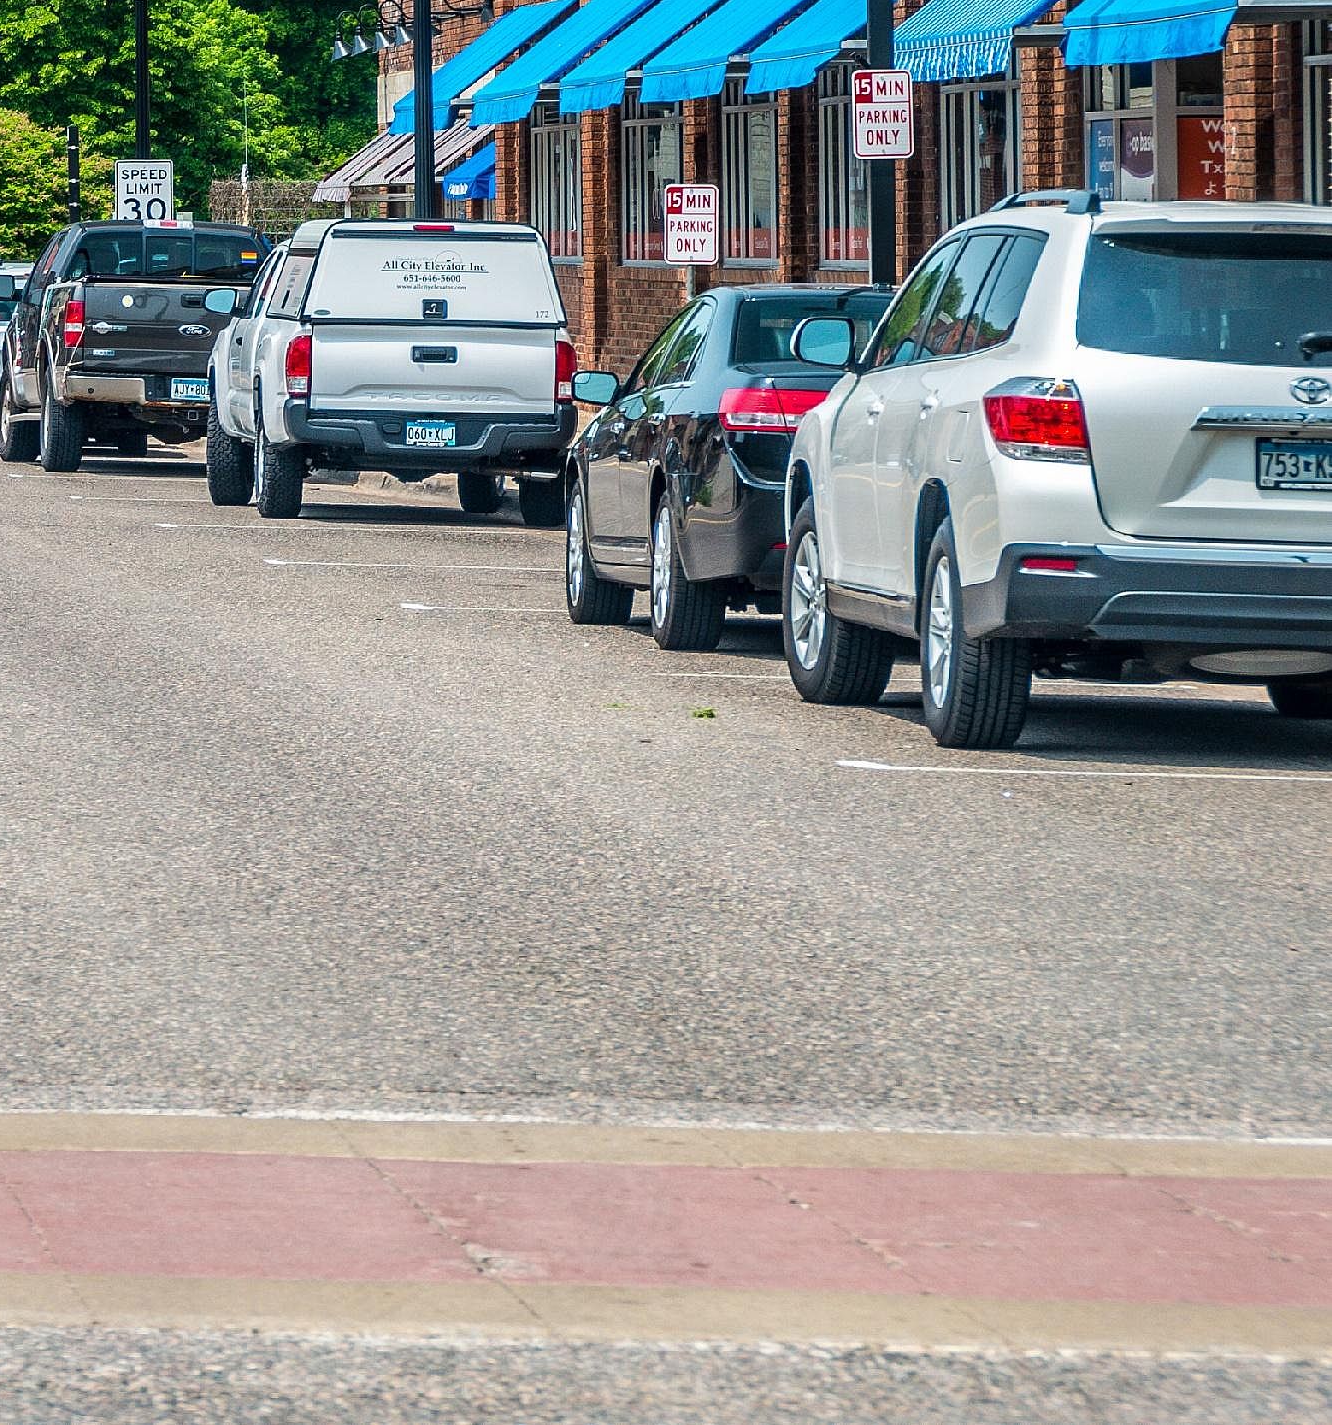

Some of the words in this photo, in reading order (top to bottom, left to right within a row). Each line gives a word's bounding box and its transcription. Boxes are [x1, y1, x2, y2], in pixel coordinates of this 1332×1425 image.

[855, 79, 871, 95] 15
[876, 80, 904, 96] MIN
[859, 109, 907, 124] PARKING
[866, 129, 900, 146] ONLY
[121, 169, 167, 180] SPEED
[126, 183, 162, 195] LIMIT
[667, 192, 681, 207] 15
[686, 194, 711, 208] MIN
[123, 197, 167, 220] 30
[670, 220, 713, 232] PARKING
[676, 238, 706, 252] ONLY
[383, 260, 398, 270] All
[401, 260, 422, 272] City
[535, 310, 549, 319] 172
[1262, 453, 1300, 478] 753
